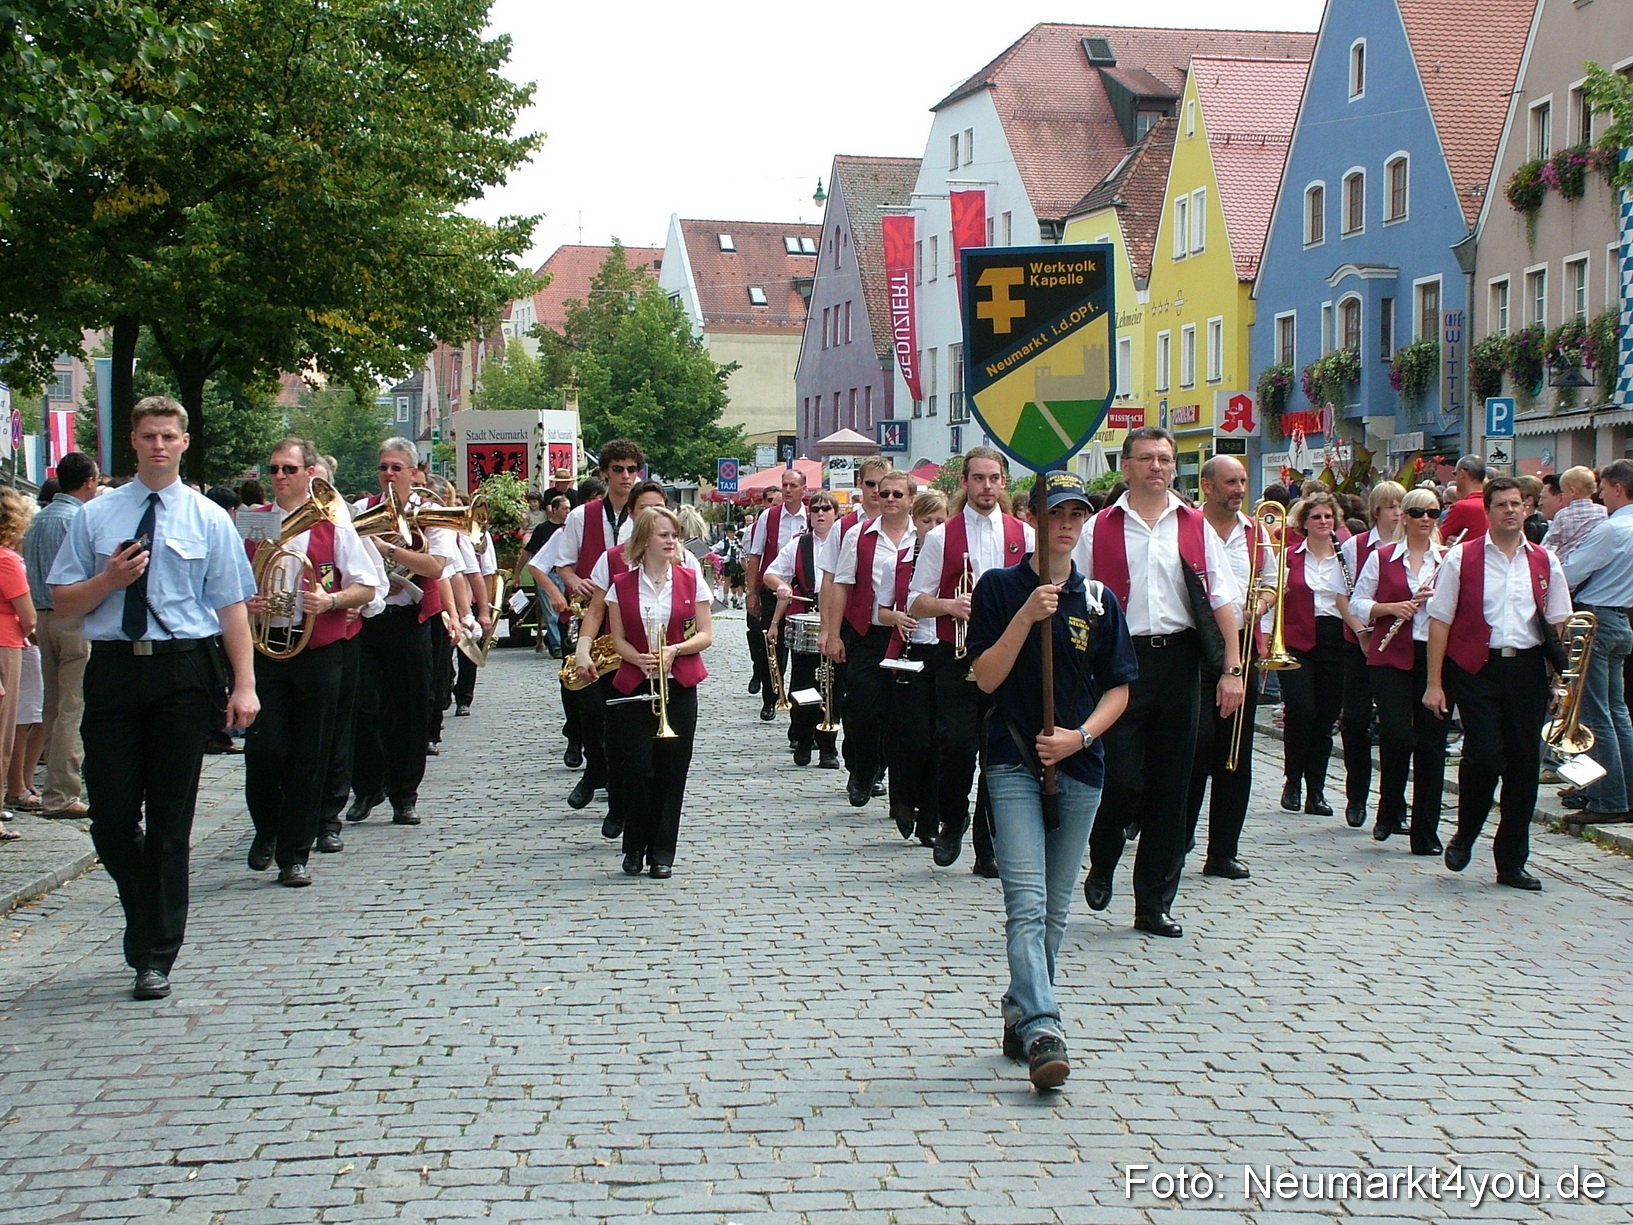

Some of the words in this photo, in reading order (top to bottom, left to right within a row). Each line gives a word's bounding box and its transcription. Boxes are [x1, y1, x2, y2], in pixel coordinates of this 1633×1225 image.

[1029, 260, 1097, 273] Werkvolk
[1029, 274, 1084, 288] Kapelle
[985, 332, 1049, 377] Neumarkt
[1051, 301, 1100, 336] i.d.OPf.
[1492, 403, 1508, 432] P
[465, 429, 487, 441] Stadt
[488, 428, 529, 441] Neumarkt
[719, 481, 737, 491] TAXI
